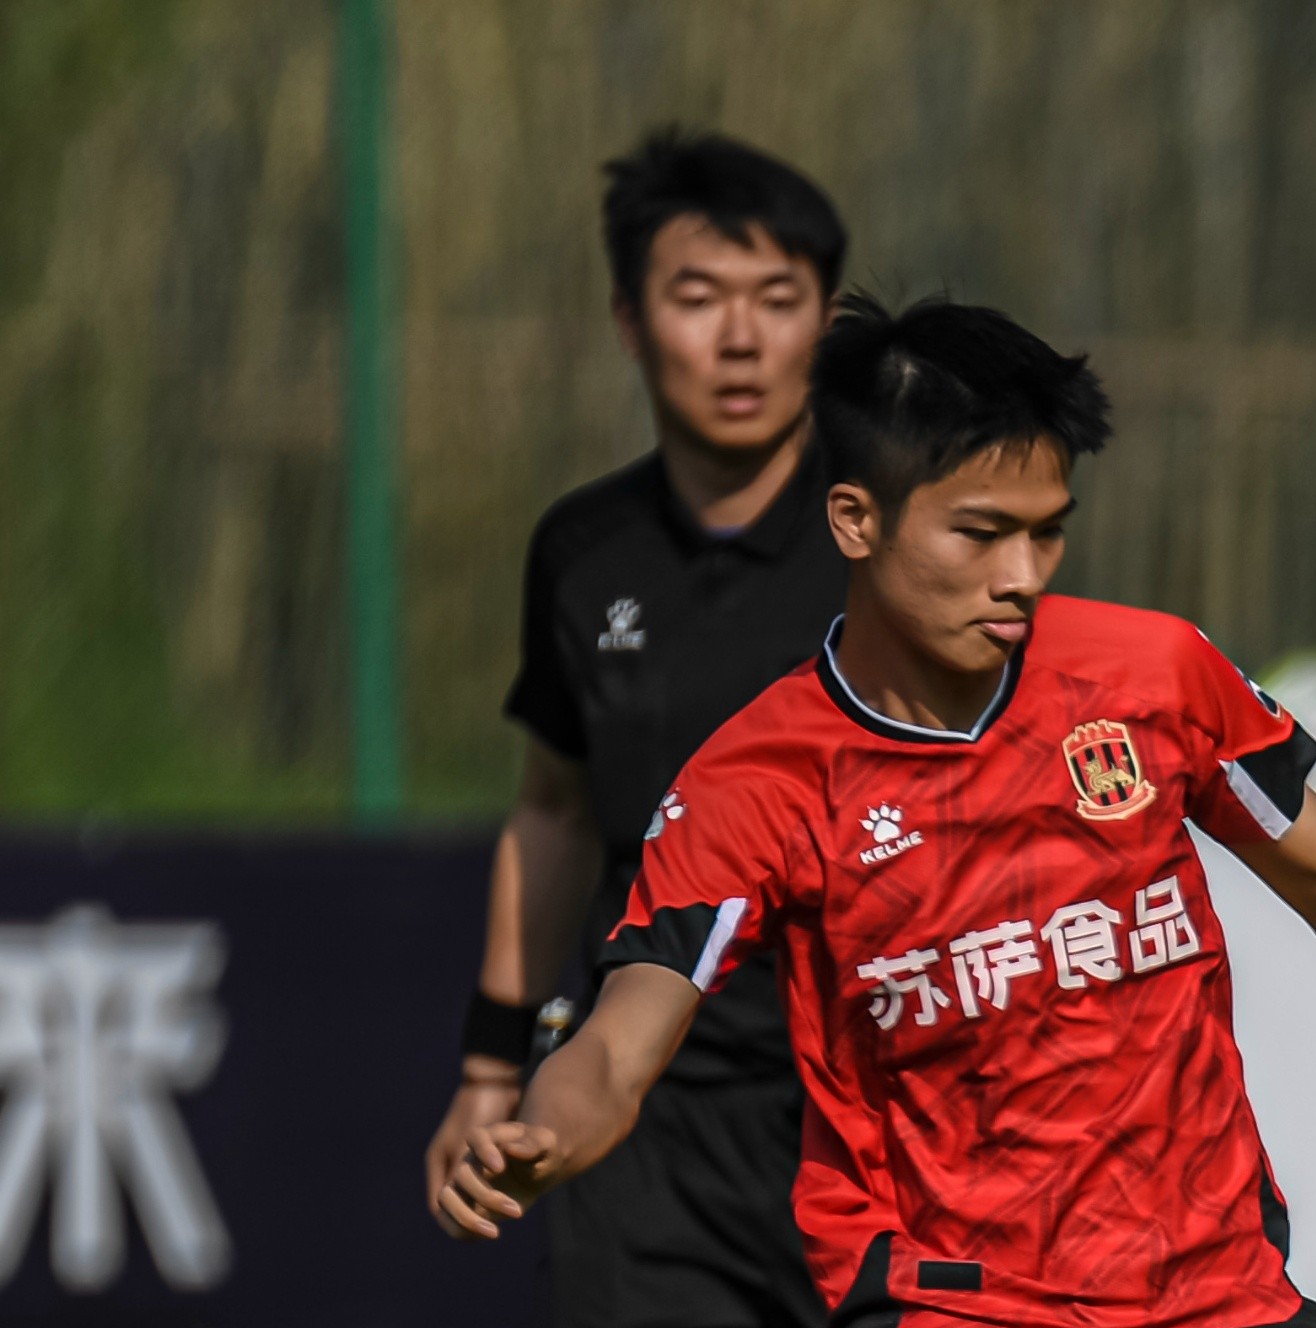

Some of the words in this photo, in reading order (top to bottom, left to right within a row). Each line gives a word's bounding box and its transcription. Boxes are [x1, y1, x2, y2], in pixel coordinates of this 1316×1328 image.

[859, 831, 924, 865] KELME
[857, 876, 1200, 1030] 苏萨食品
